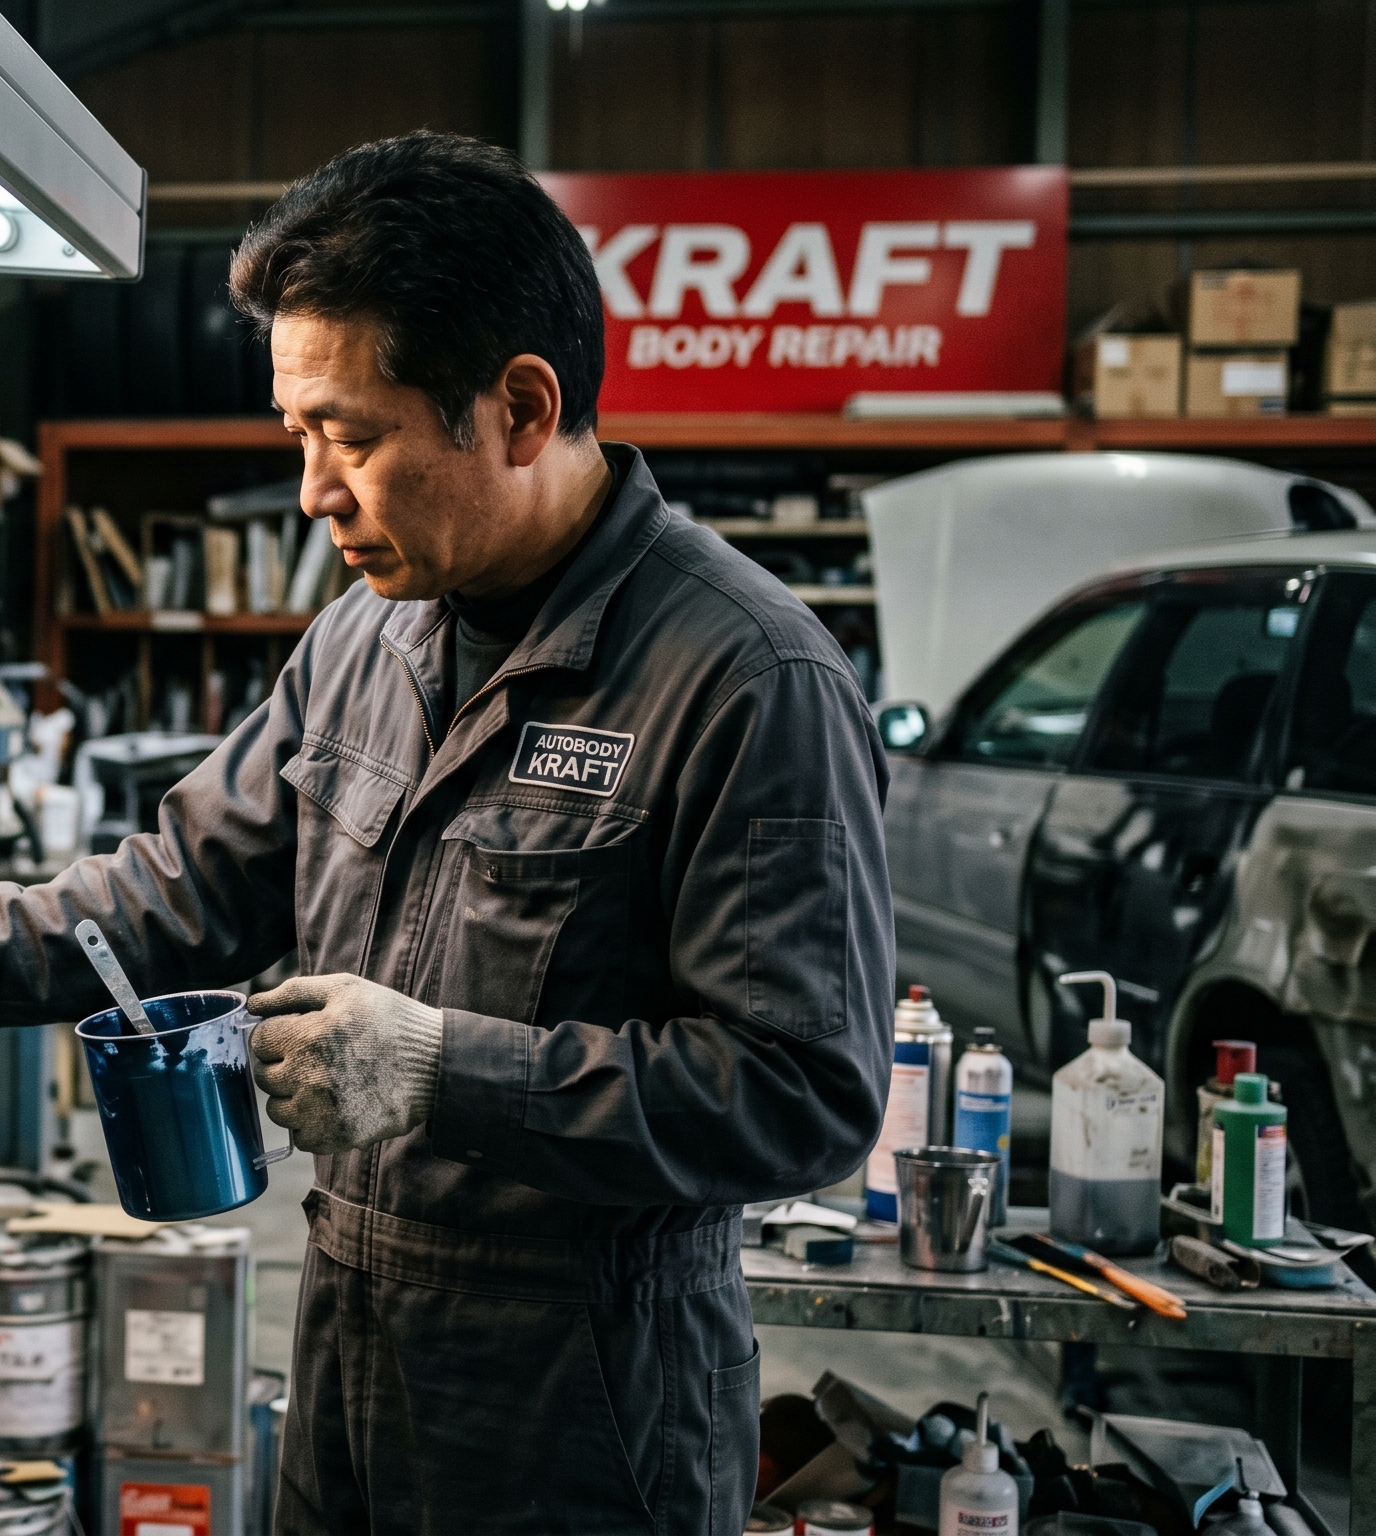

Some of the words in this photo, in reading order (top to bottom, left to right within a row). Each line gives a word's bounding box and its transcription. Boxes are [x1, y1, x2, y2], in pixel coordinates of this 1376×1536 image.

[578, 223, 1036, 319] KRAFT
[628, 326, 762, 369] BODY
[769, 325, 941, 367] REPAIR
[535, 735, 623, 759] AUTOBODY
[528, 752, 619, 786] KRAFT
